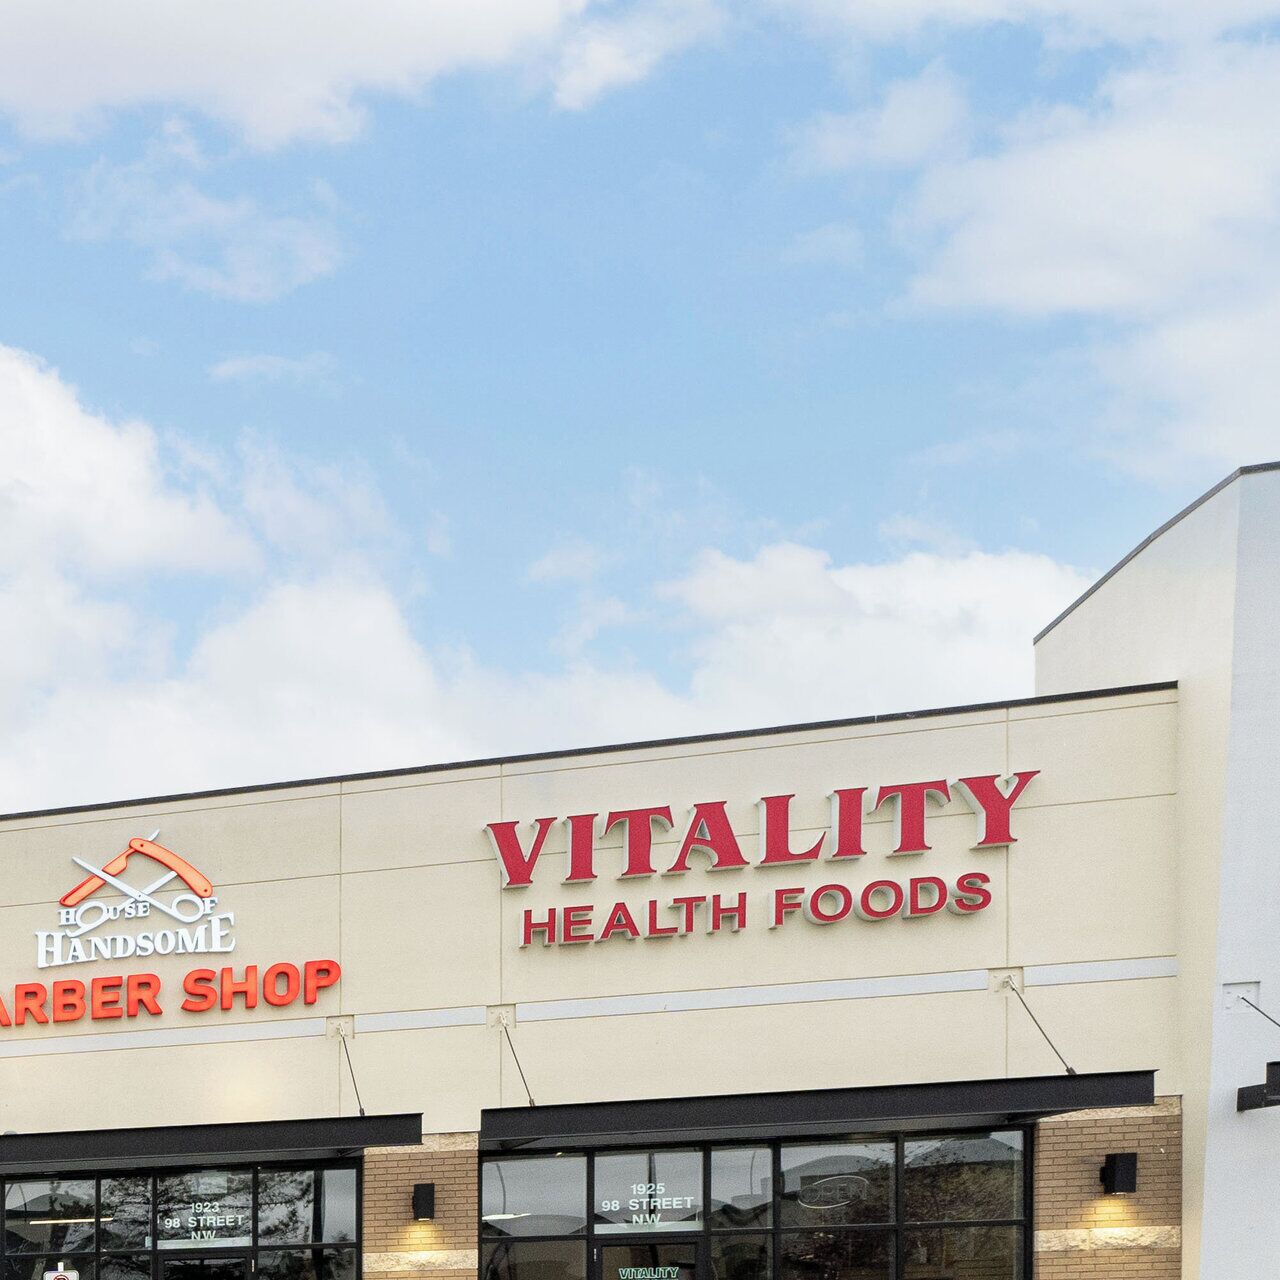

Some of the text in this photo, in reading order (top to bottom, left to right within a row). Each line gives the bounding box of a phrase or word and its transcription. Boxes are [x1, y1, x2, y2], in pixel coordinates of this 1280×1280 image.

[484, 770, 1041, 890] VITALITY
[519, 872, 993, 948] HEALTH FOODS
[35, 912, 236, 968] HANDSOME
[180, 959, 341, 1013] SHOP
[630, 1182, 666, 1195] 1925
[191, 1201, 220, 1213] 1923
[601, 1196, 695, 1212] 98 STREET
[164, 1214, 245, 1229] 98 STREET
[618, 1267, 679, 1279] VITALITY
